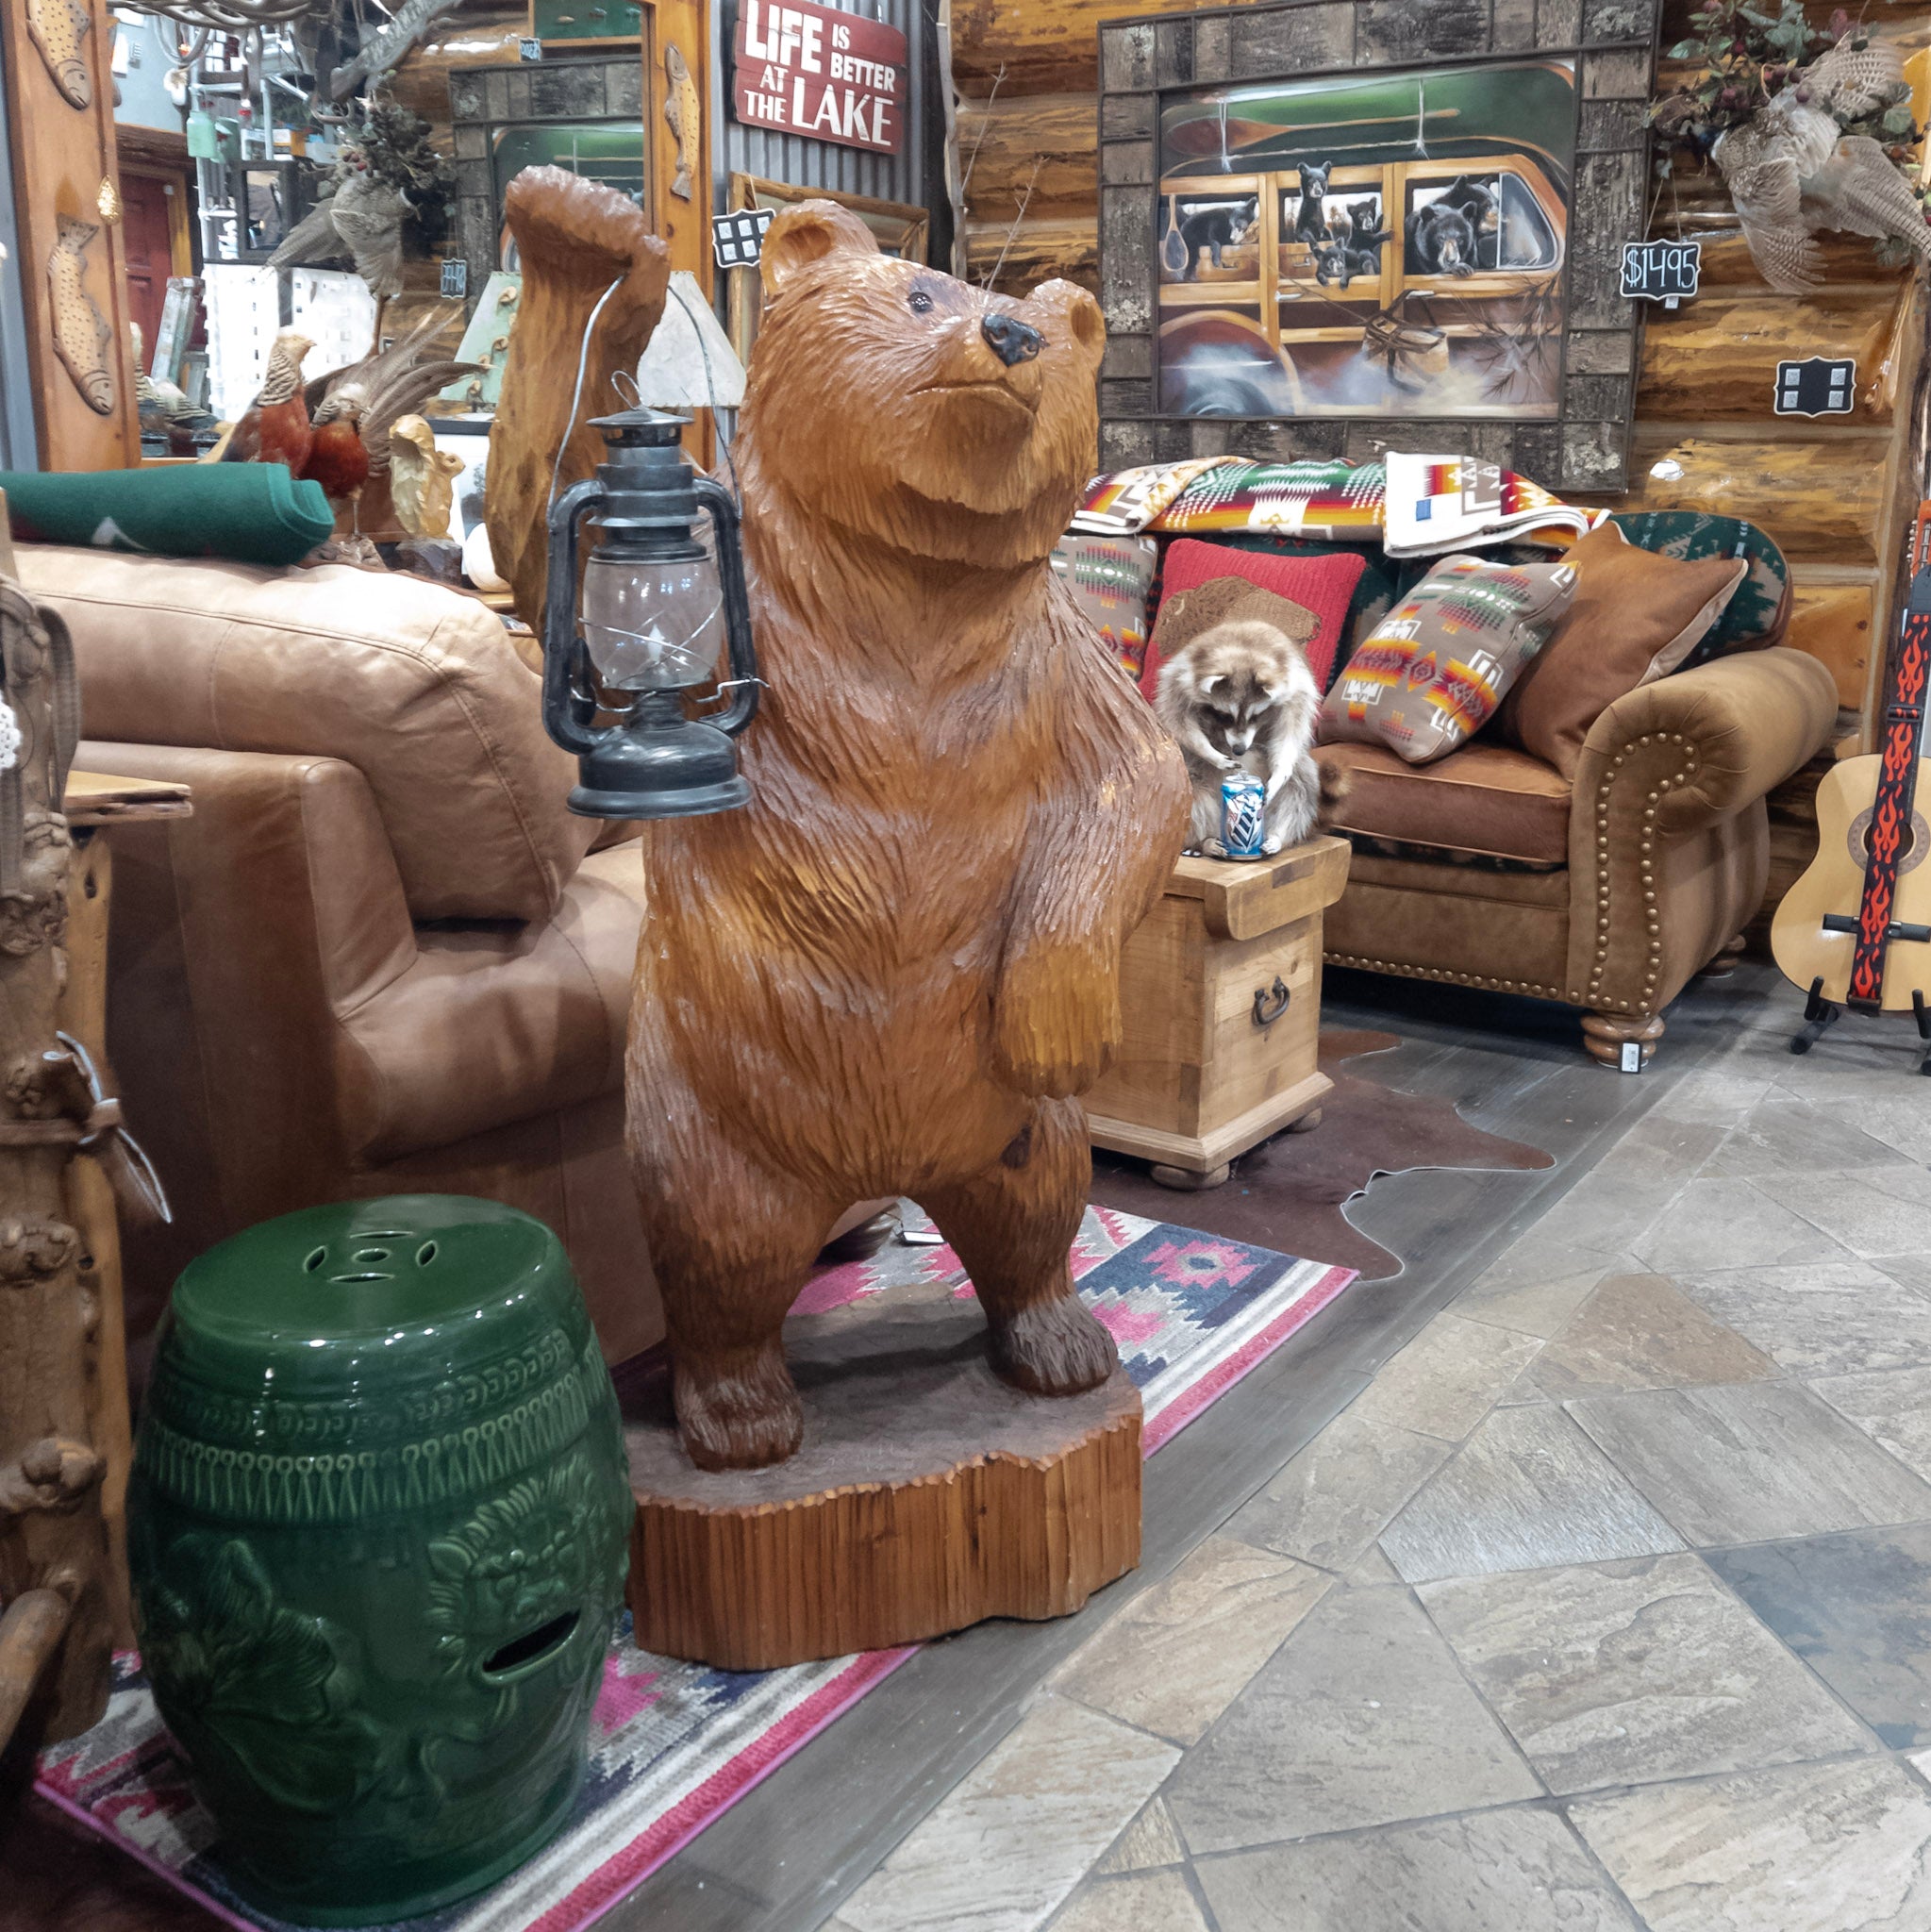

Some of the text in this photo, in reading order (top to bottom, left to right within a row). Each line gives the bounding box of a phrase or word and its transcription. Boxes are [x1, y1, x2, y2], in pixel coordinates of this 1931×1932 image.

[745, 0, 851, 74] LIFE IS
[759, 64, 789, 93] AT
[830, 52, 895, 92] BETTER
[743, 75, 893, 146] THE LAKE
[1625, 246, 1697, 289] $1495
